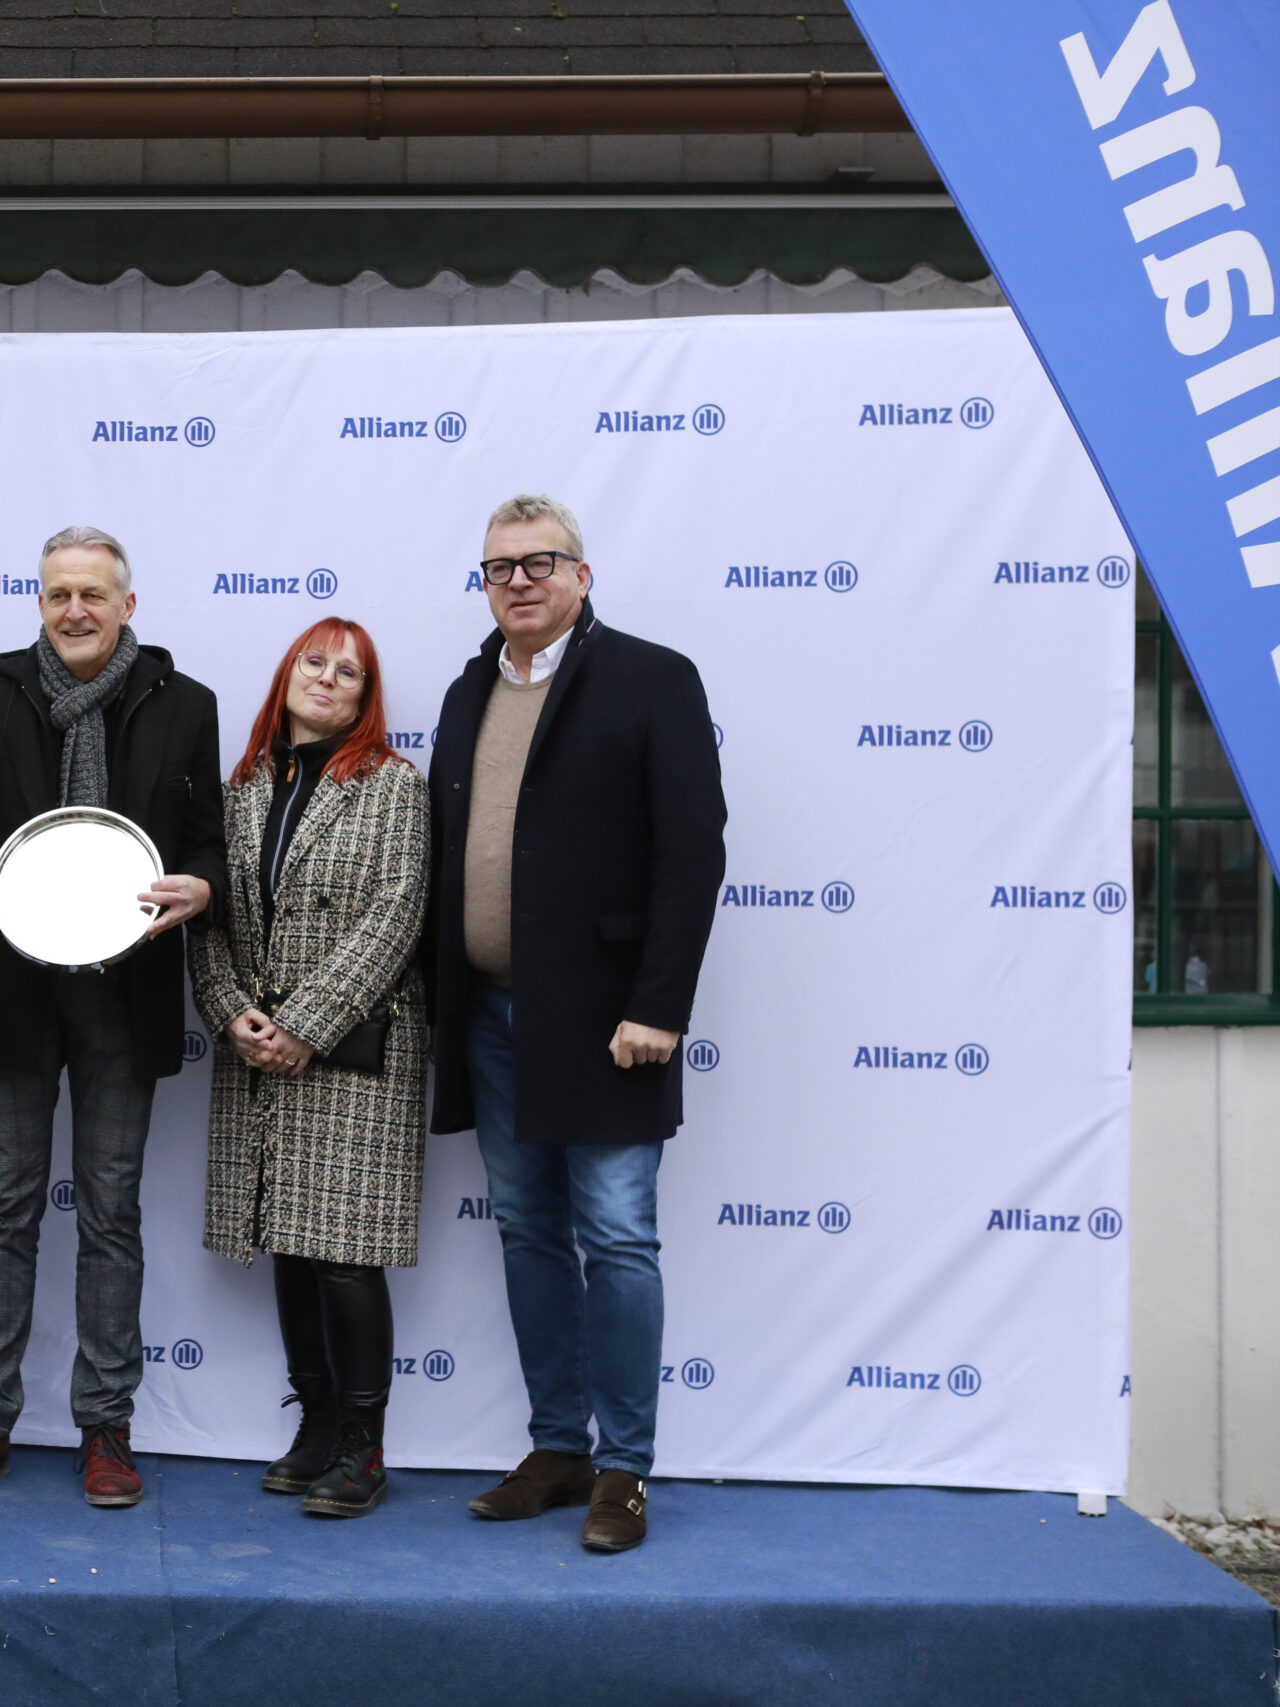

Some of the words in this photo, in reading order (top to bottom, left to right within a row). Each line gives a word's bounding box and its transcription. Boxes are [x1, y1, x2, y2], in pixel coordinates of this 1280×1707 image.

[595, 410, 686, 433] Allianz
[858, 403, 953, 427] Allianz
[92, 420, 178, 442] Allianz
[340, 416, 428, 439] Allianz
[213, 572, 300, 595] Allianz
[724, 565, 818, 588] Allianz
[995, 561, 1089, 584] Allianz
[857, 724, 952, 747] Allianz
[721, 884, 815, 908] Allianz
[991, 885, 1086, 908] Allianz
[853, 1045, 948, 1070] Allianz
[717, 1202, 811, 1228] Allianz
[986, 1208, 1081, 1233] Allianz
[846, 1365, 941, 1391] Allianz
